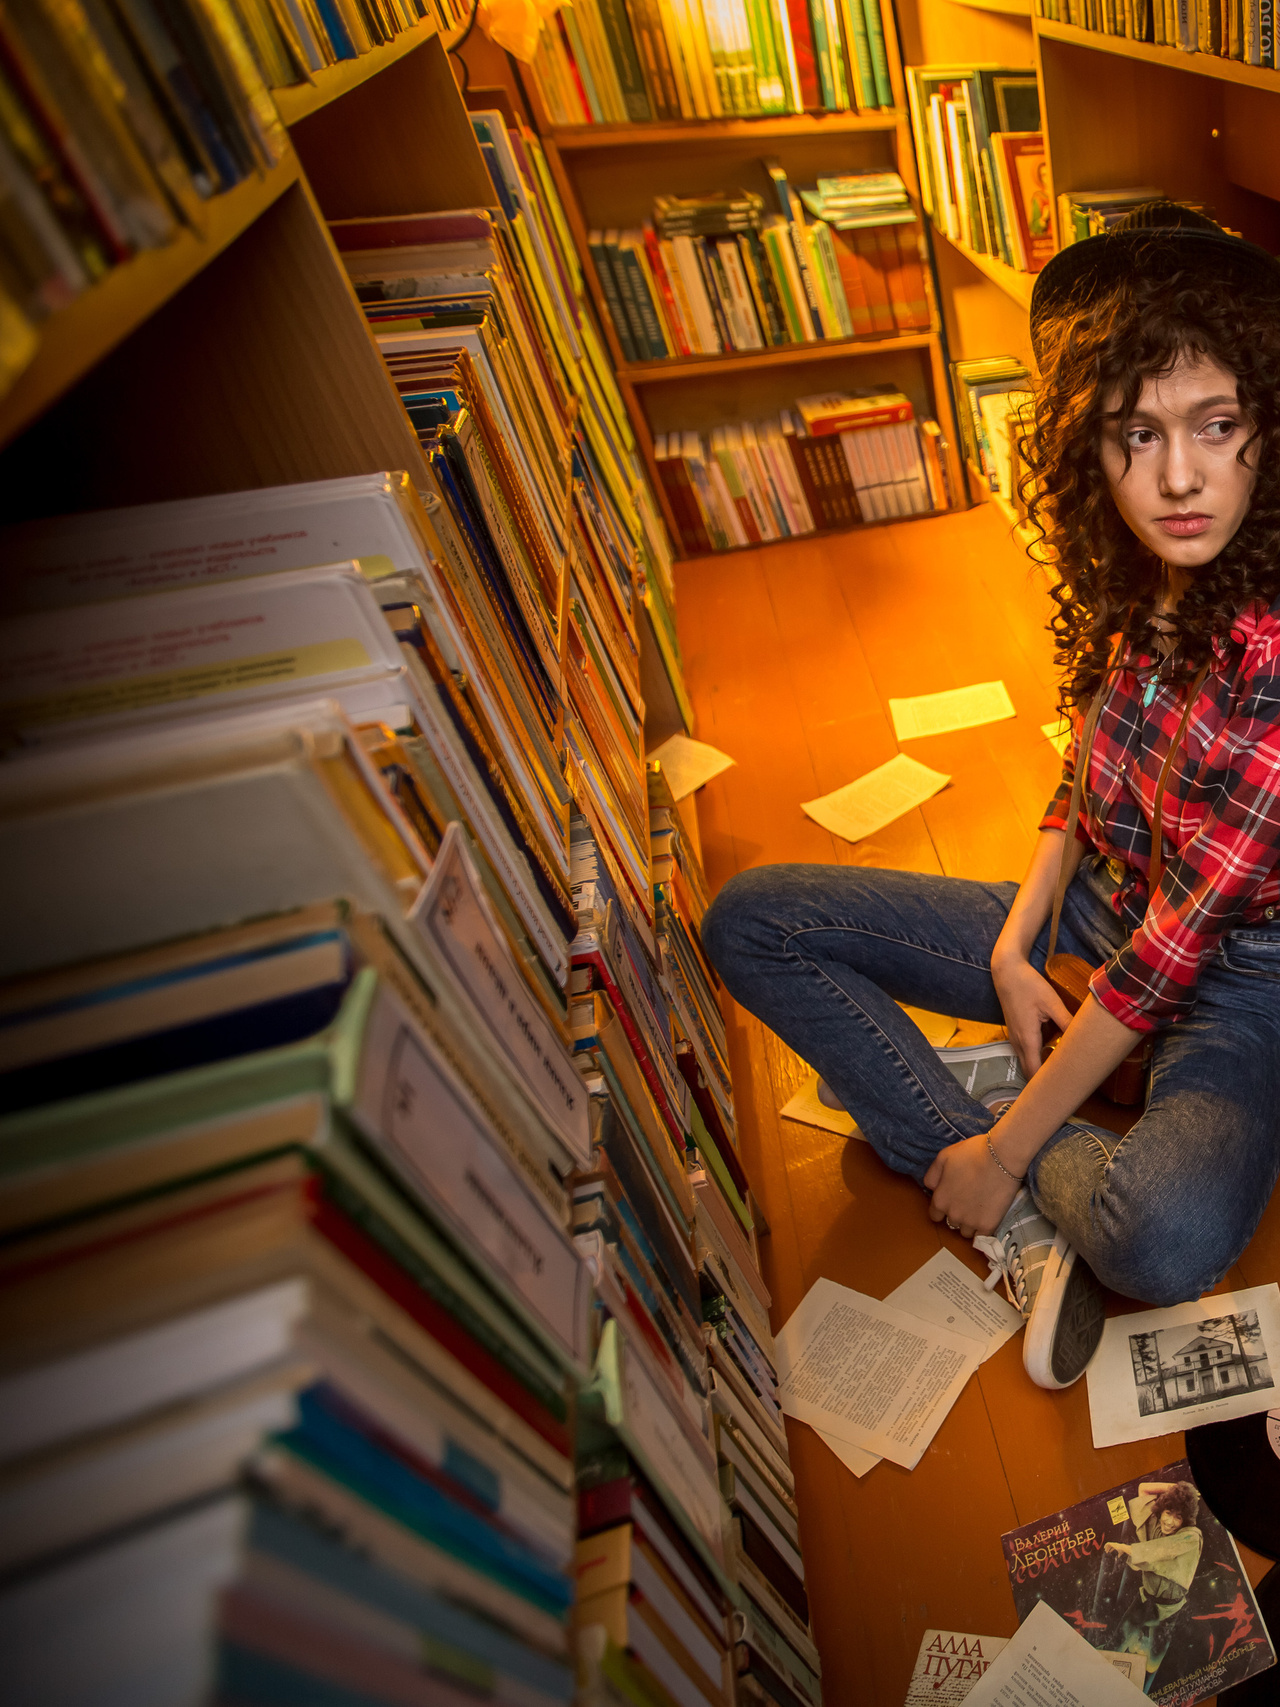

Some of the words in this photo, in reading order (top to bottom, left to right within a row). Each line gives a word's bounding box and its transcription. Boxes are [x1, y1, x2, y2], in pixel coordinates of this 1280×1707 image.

[1013, 1520, 1070, 1552] ВАЛЕРИЙ
[1010, 1528, 1097, 1573] ЛЕОНТЬЕВ
[925, 1633, 984, 1657] АЛЛА
[1226, 1640, 1257, 1661] СОЛНЦЕ
